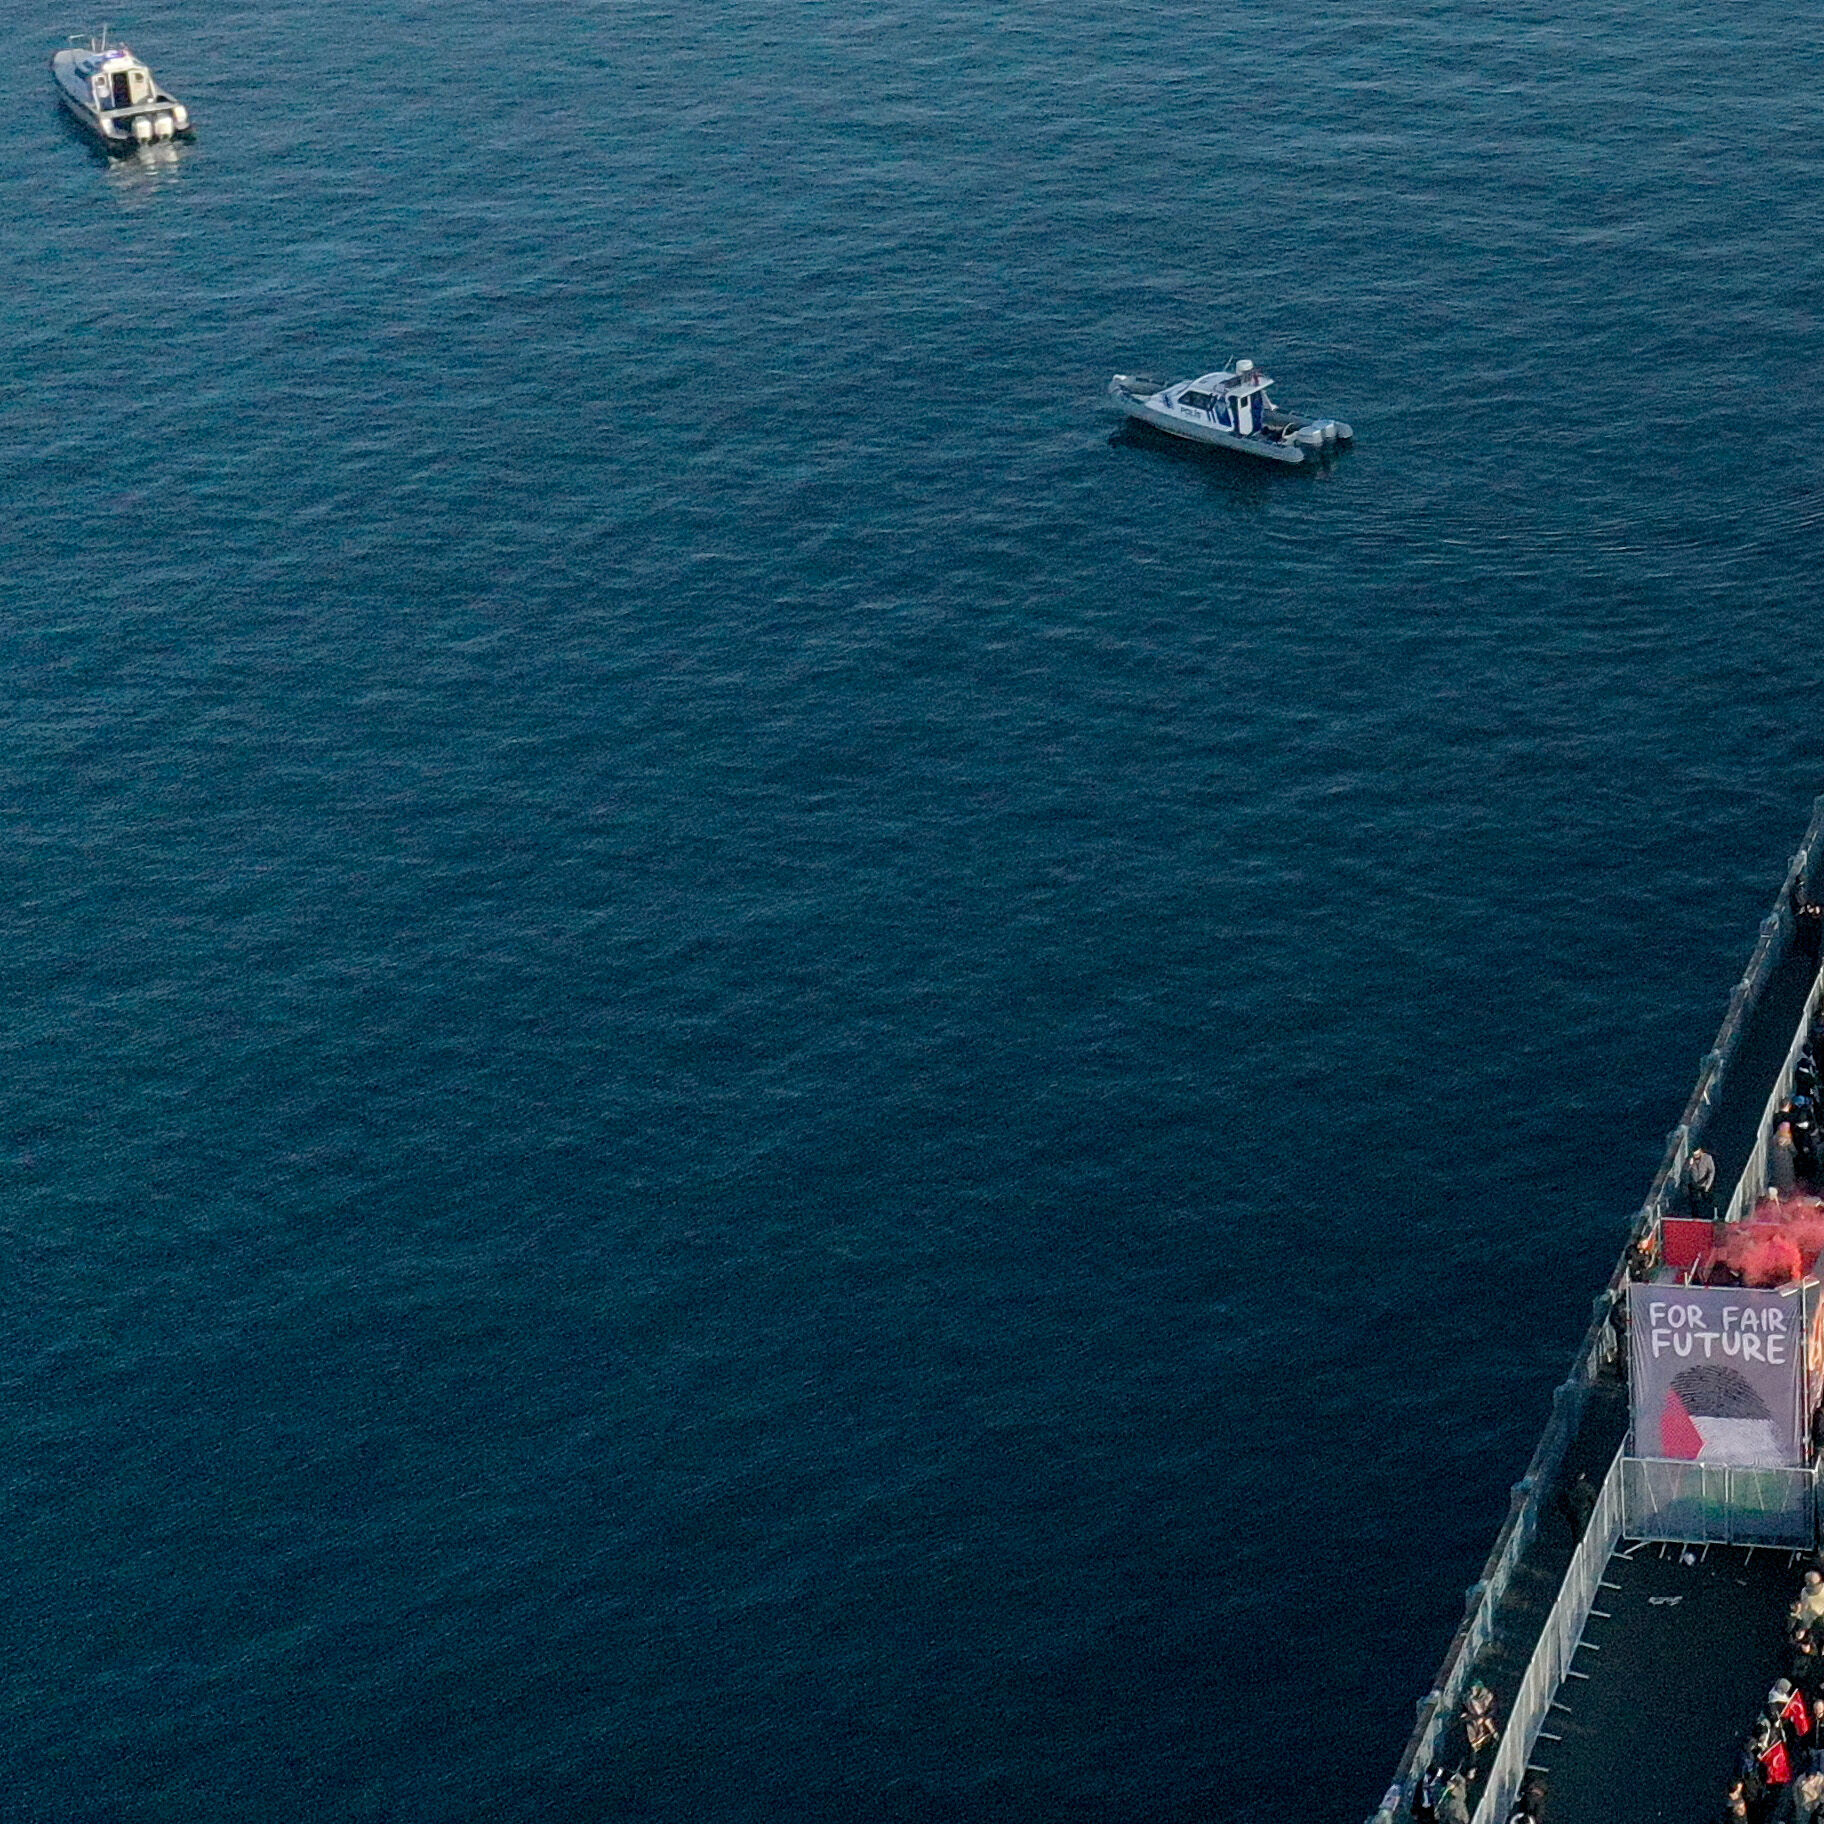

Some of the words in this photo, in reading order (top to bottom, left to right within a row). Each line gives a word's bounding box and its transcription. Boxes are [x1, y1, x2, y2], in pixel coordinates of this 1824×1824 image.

[1650, 1302, 1706, 1328] FOR
[1722, 1306, 1787, 1332] FAIR
[1652, 1329, 1786, 1365] FUTURE
